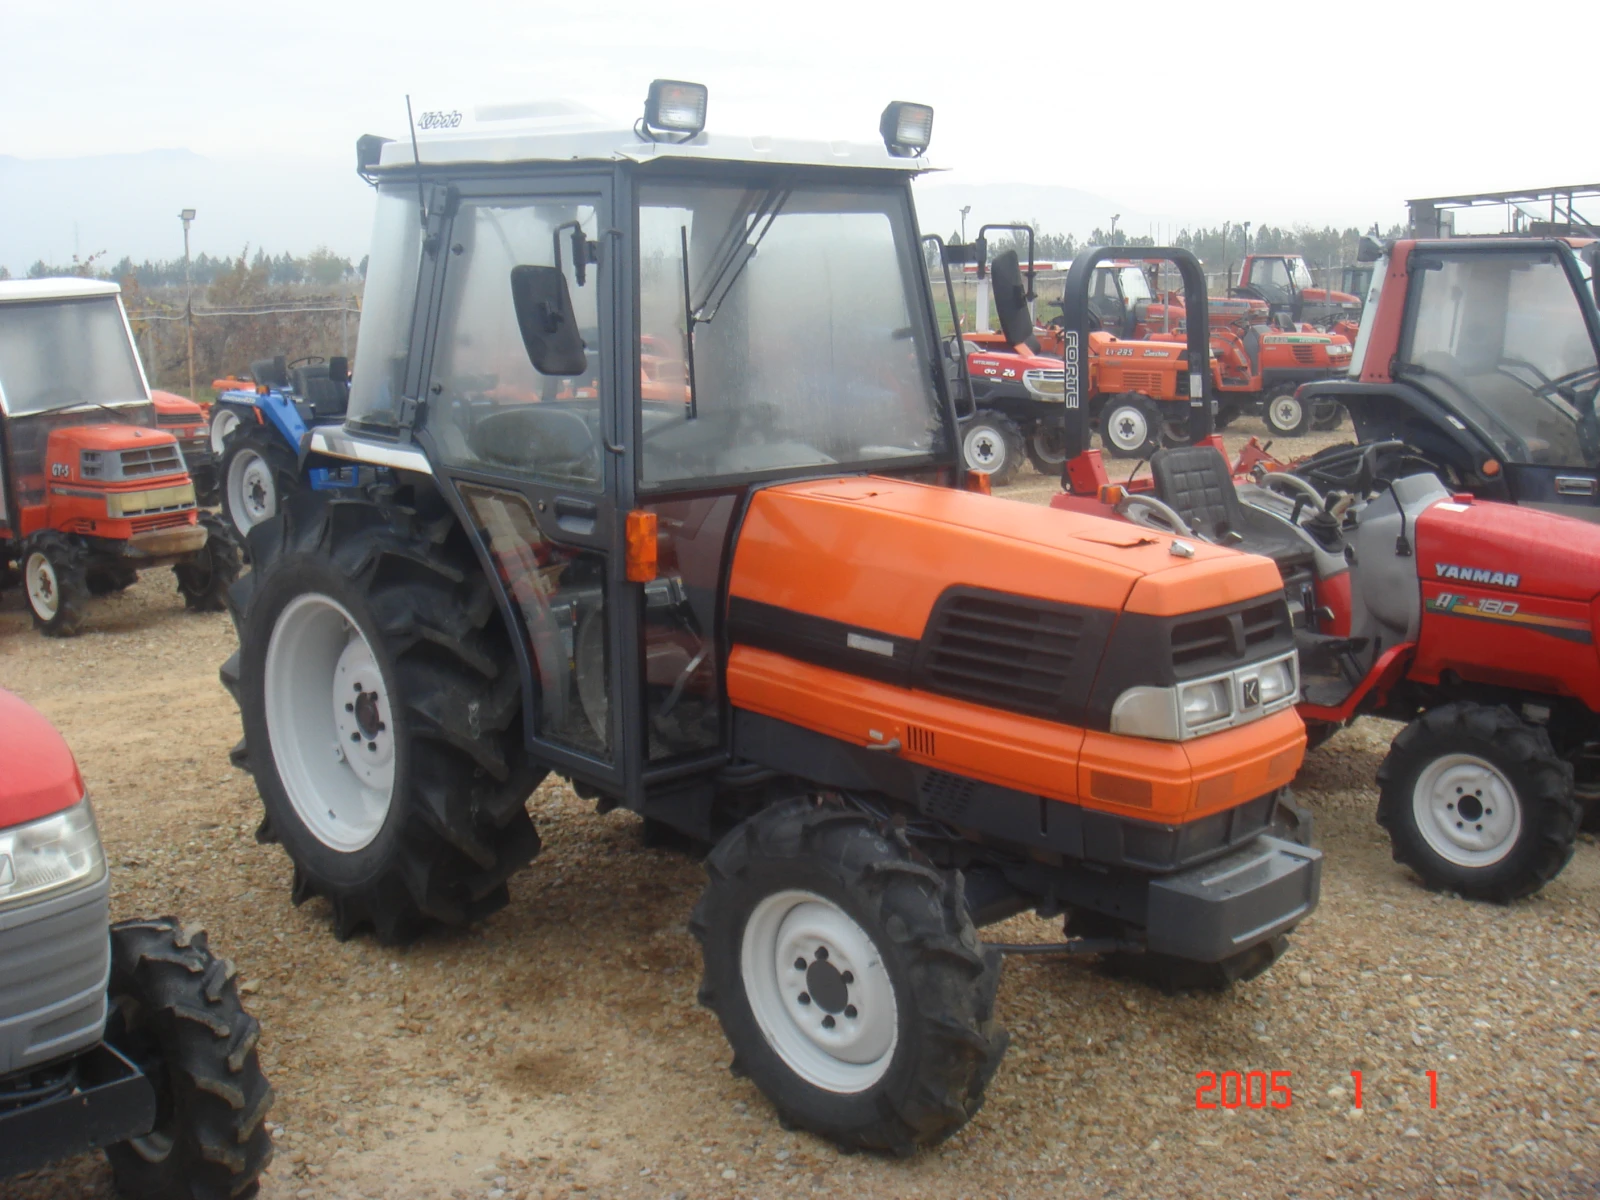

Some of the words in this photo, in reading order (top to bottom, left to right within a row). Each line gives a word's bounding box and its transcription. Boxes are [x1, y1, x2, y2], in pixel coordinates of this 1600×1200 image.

[417, 110, 463, 129] Kubota
[1002, 368, 1016, 378] 26
[1065, 331, 1079, 408] FORTE
[1435, 562, 1521, 588] YANMAR
